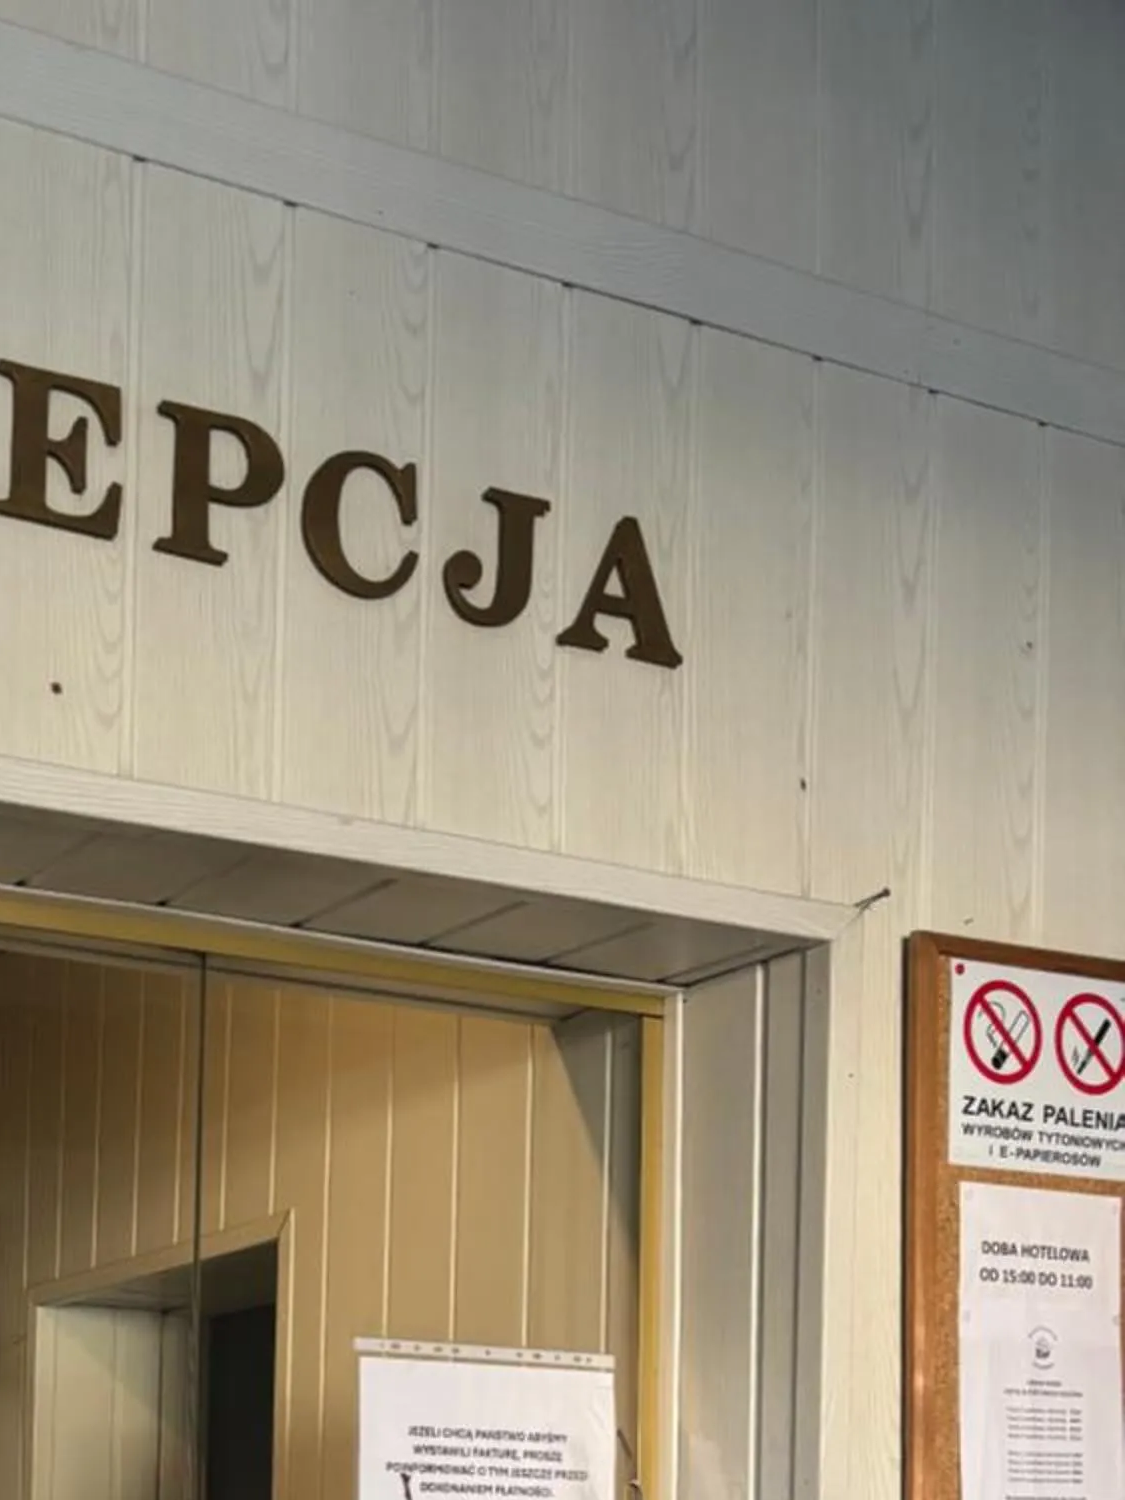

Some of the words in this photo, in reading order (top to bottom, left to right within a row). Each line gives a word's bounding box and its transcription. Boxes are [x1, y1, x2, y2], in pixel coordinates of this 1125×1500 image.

[962, 1095, 1034, 1122] ZAKAZ
[1043, 1104, 1125, 1131] PALENIA
[961, 1122, 1033, 1141] WYROBÓW
[999, 1145, 1101, 1168] E-PAPIEROSÓW
[981, 1240, 1017, 1256] DOBA
[1021, 1243, 1091, 1262] HOTELOWA
[979, 1267, 999, 1282] OD
[1002, 1269, 1036, 1285] 15:00
[1038, 1271, 1057, 1287] DO
[1060, 1273, 1094, 1290] 11:00
